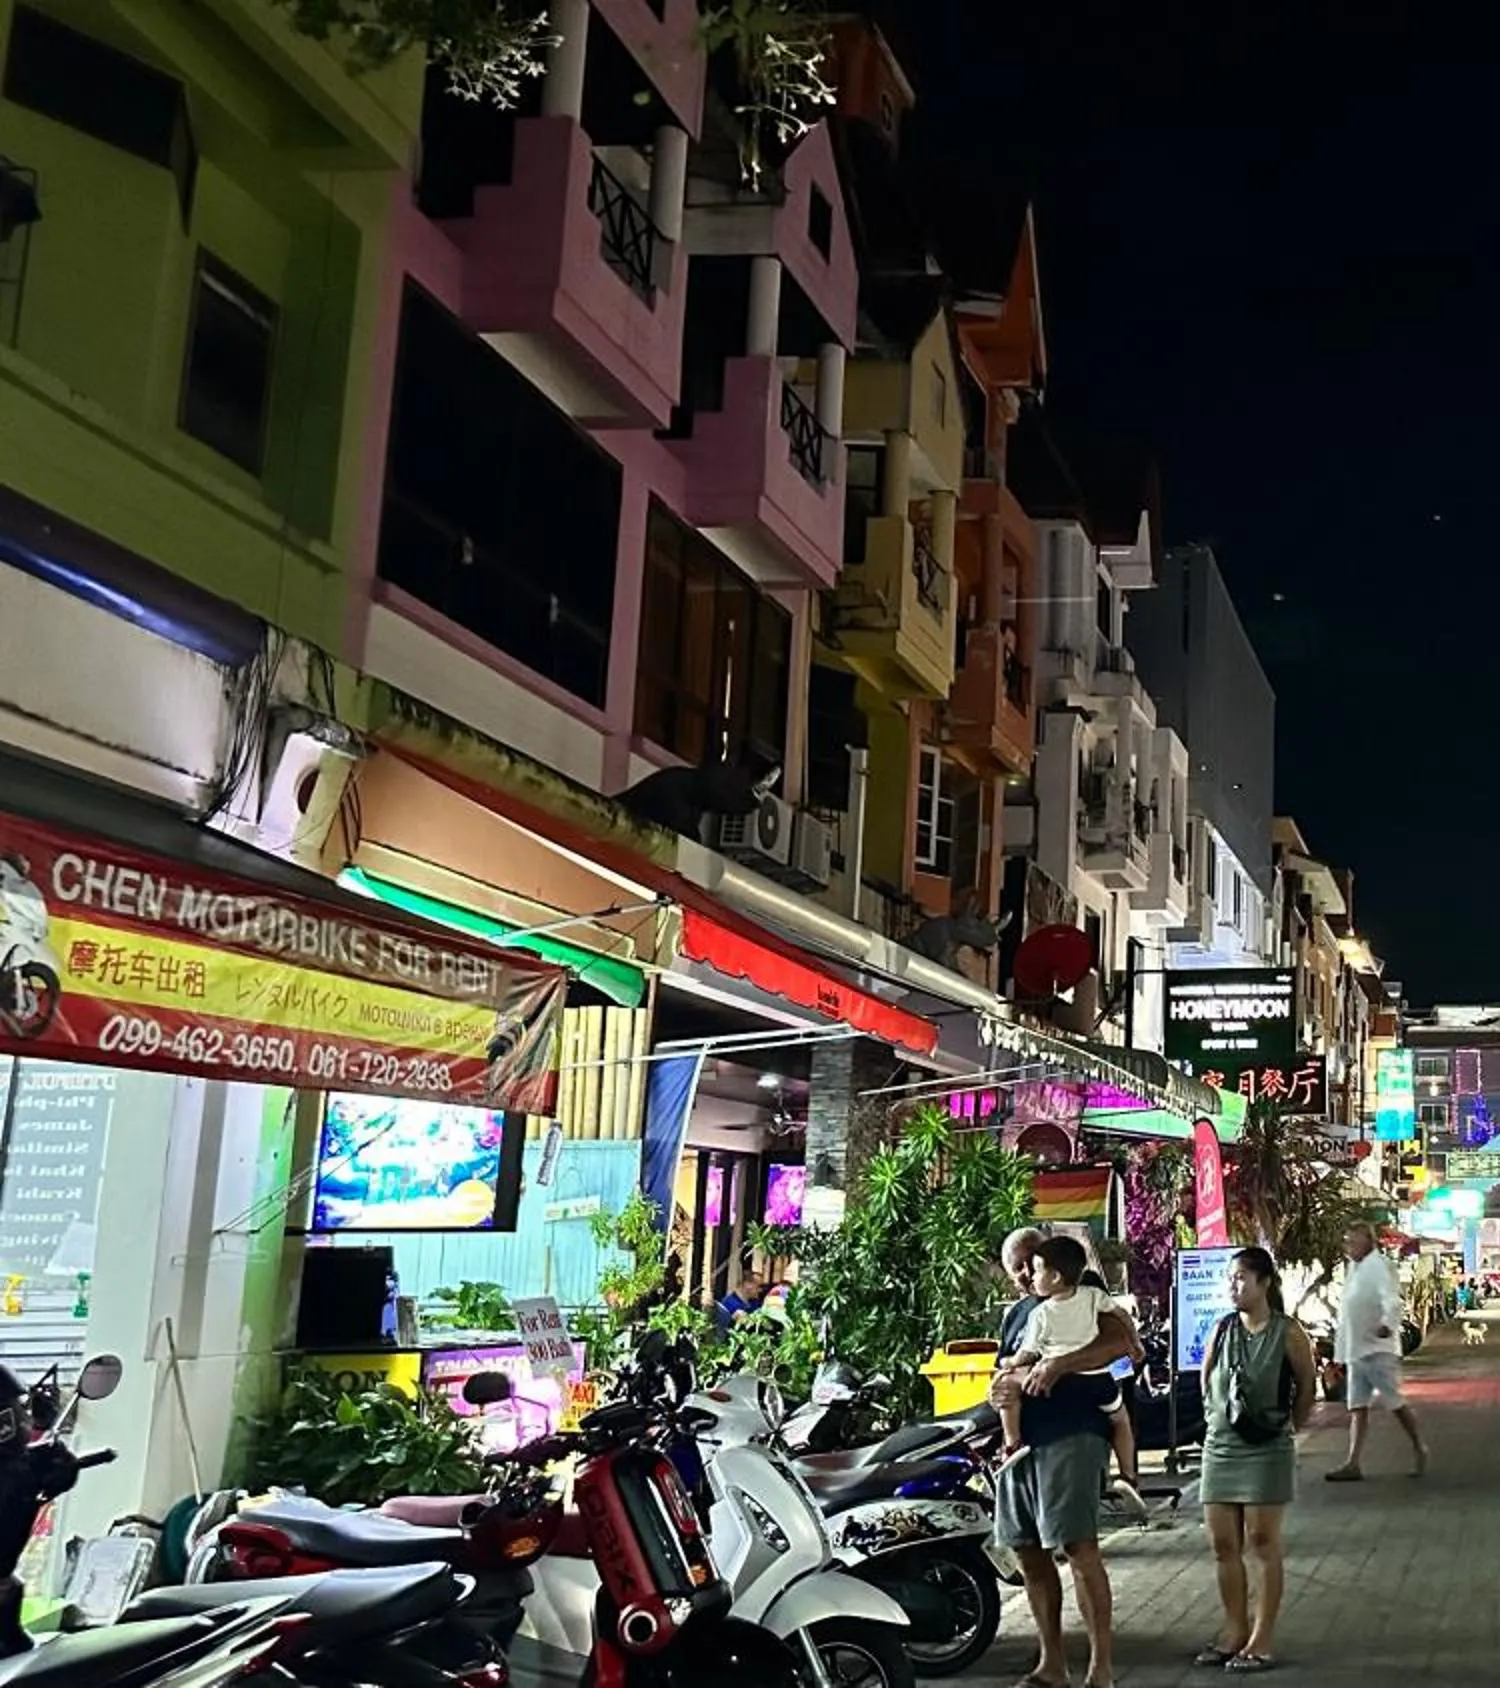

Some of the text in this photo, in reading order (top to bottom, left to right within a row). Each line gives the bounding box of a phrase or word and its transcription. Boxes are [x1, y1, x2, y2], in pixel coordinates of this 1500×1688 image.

[52, 853, 503, 998] CHEN MOTORBIKE FOR RENT
[67, 938, 206, 998] 摩托车出租
[1170, 998, 1290, 1020] HONEYMOON
[307, 1043, 454, 1092] 061-720-2938
